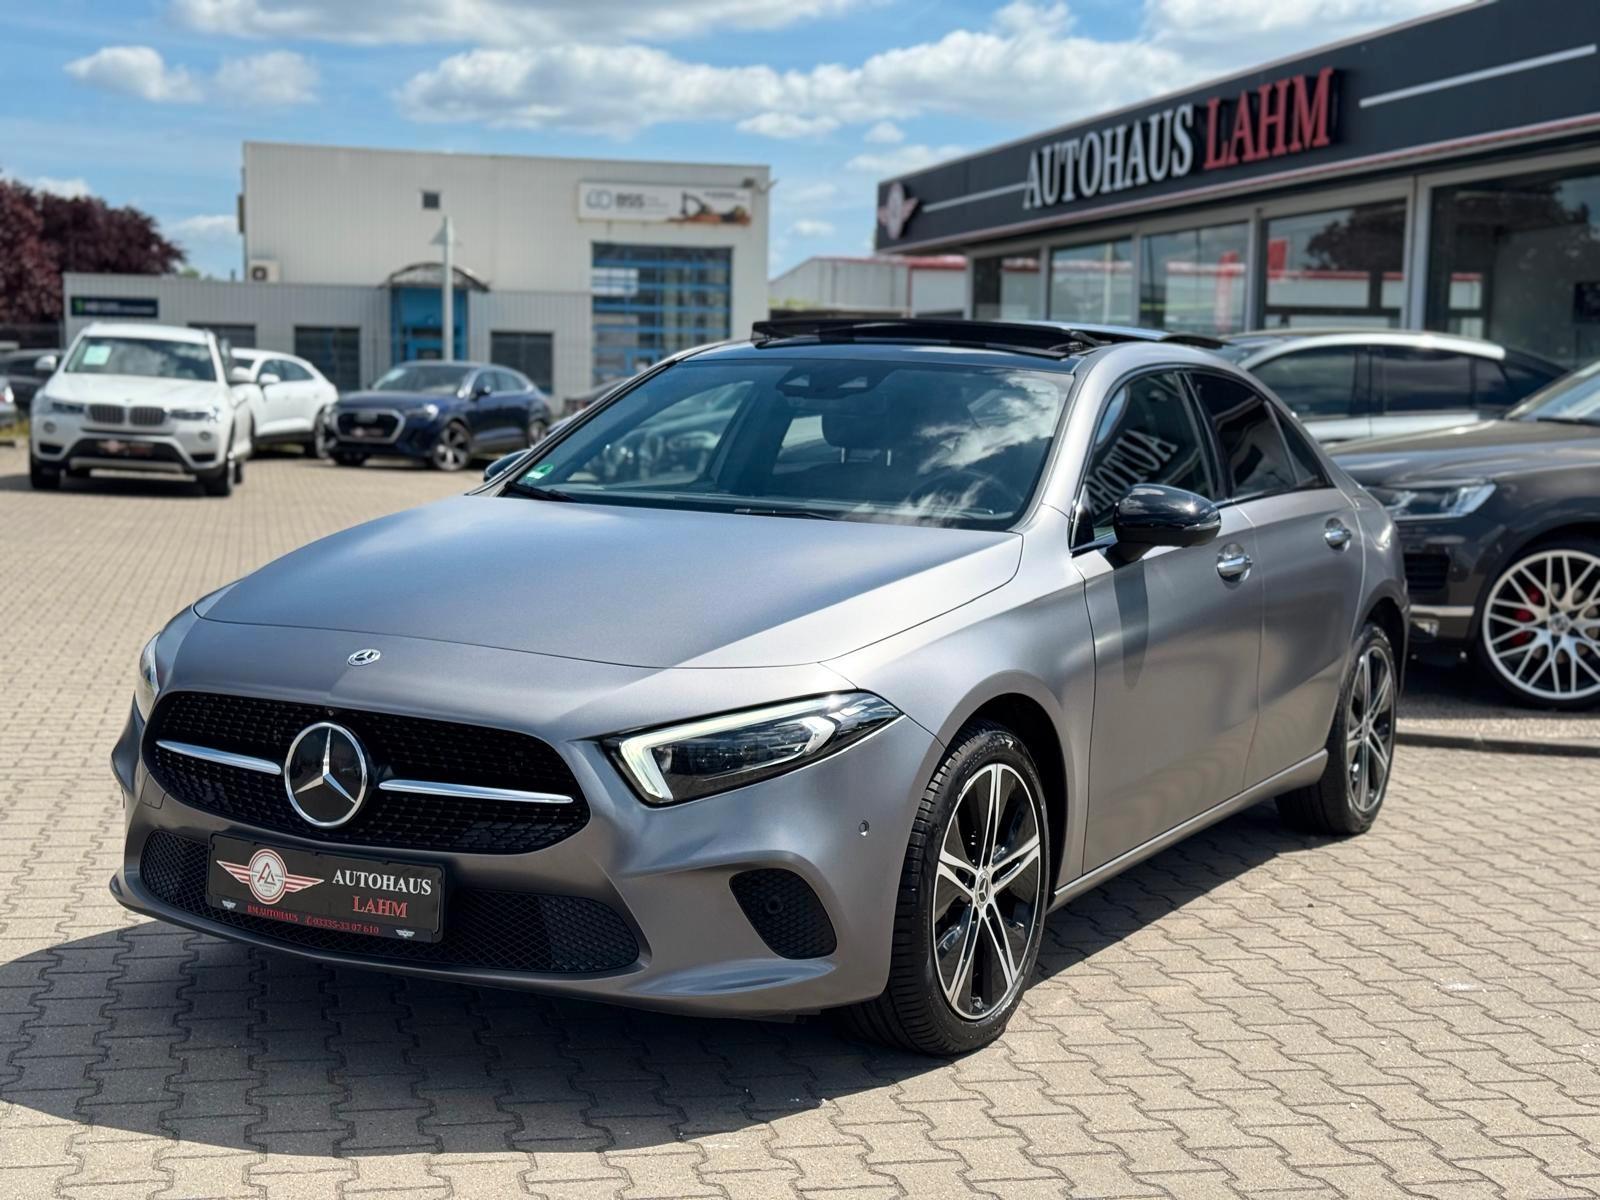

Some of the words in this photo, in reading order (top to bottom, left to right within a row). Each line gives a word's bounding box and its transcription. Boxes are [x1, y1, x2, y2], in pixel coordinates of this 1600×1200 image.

[1022, 103, 1193, 210] AUTOHAUS
[1203, 66, 1334, 170] LAHM
[332, 869, 432, 895] AUTOHAUS
[353, 896, 408, 918] LAHM
